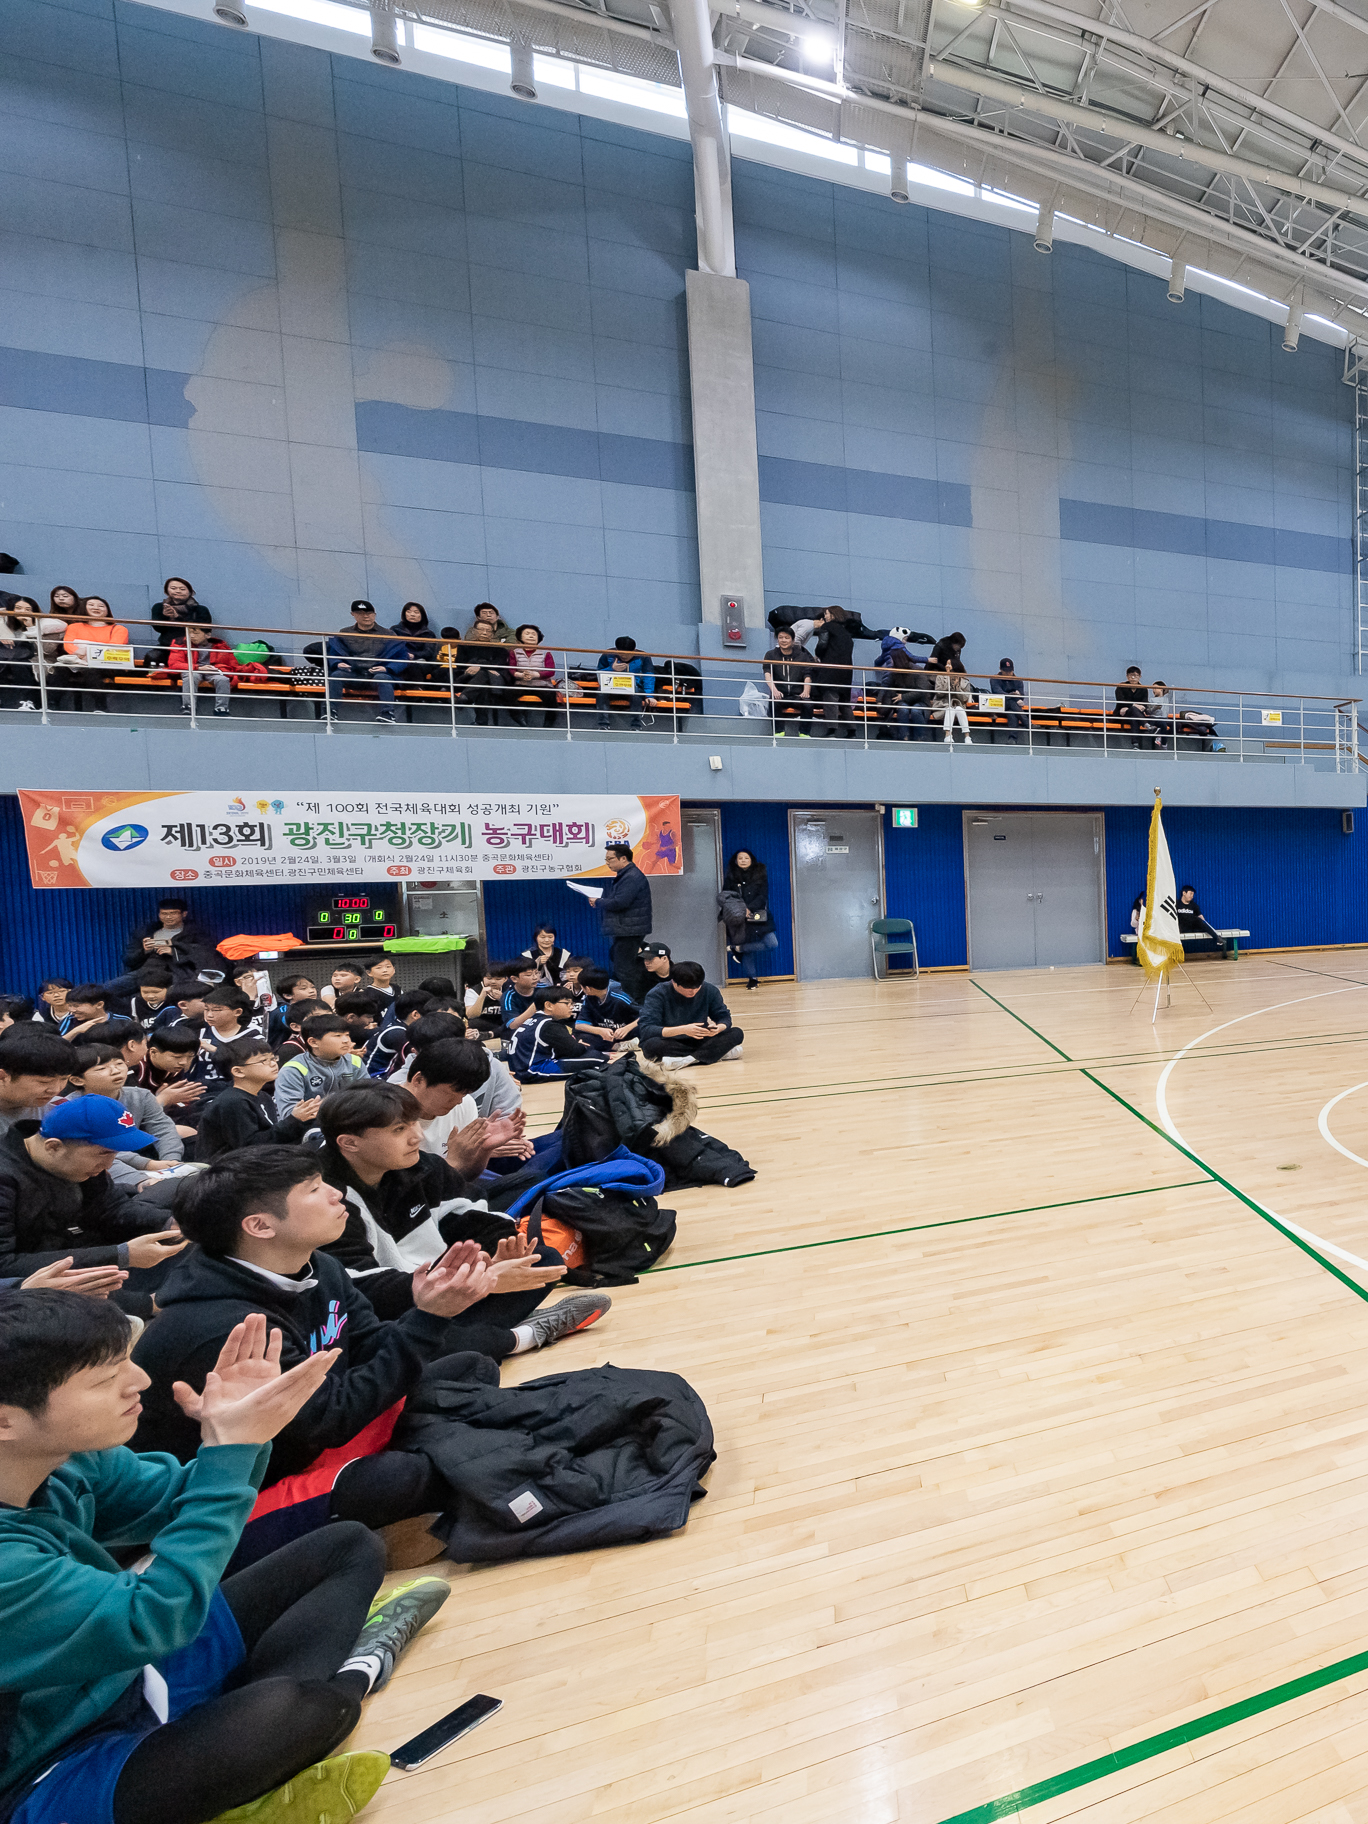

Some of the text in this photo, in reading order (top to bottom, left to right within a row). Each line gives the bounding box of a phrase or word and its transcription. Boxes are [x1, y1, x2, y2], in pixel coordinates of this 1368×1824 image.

[326, 802, 369, 815] 100회
[375, 802, 461, 816] 전국체육대회
[466, 802, 521, 816] 성공개최
[160, 821, 592, 849] 제13회 광진구청장기 농구대회
[212, 857, 235, 867] 일시
[240, 856, 276, 866] 2019년
[326, 855, 357, 864] 3월3일
[363, 854, 395, 864] (개회식
[398, 854, 434, 863] 2월24일
[438, 853, 479, 863] 11시30분
[174, 869, 196, 880] 장소
[389, 866, 411, 876] 주최
[417, 865, 473, 875] 광진구체육회
[495, 864, 515, 874] 주관
[521, 863, 583, 874] 광진구농구협회
[320, 912, 329, 922] 0
[345, 913, 360, 923] 30
[375, 910, 384, 920] 0
[333, 927, 344, 939] 0
[349, 930, 357, 940] 0
[384, 925, 394, 937] 0
